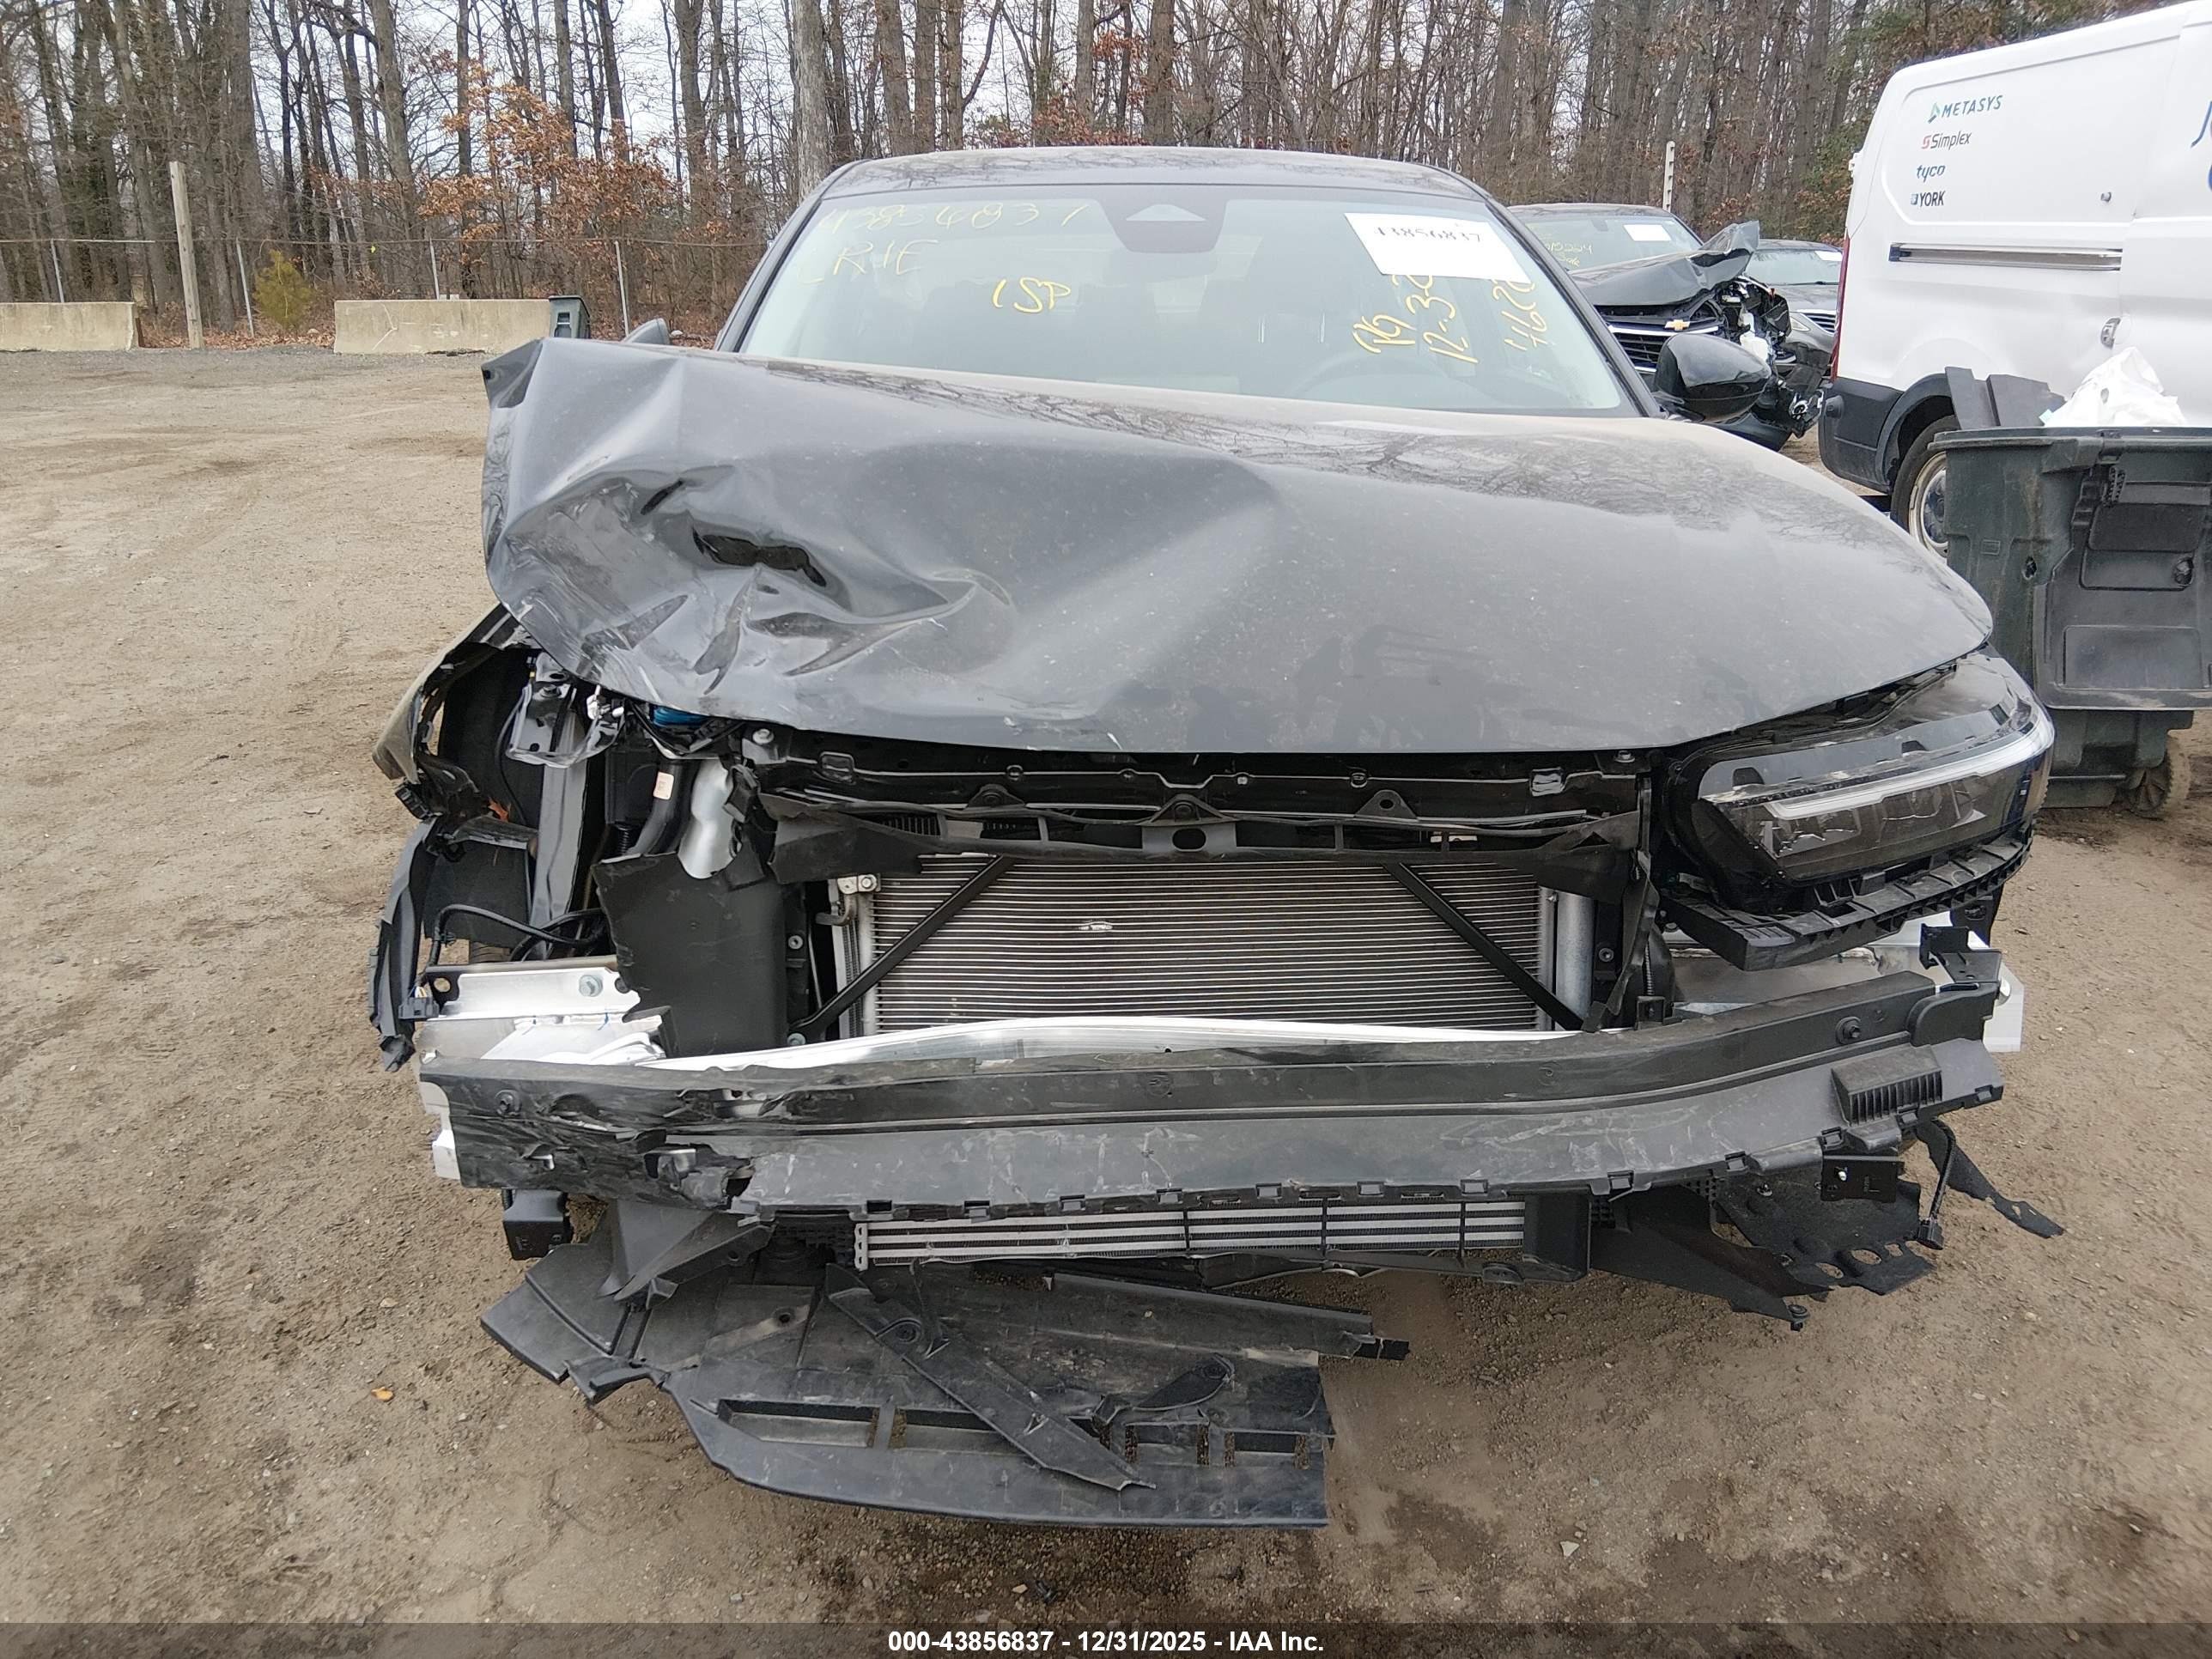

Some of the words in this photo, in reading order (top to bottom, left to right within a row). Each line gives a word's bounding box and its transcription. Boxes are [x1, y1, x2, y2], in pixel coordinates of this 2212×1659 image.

[1942, 94, 2003, 118] METASYS
[1930, 131, 1972, 150] Simplex
[1916, 164, 1946, 182] tyco
[1919, 191, 1946, 207] YORK
